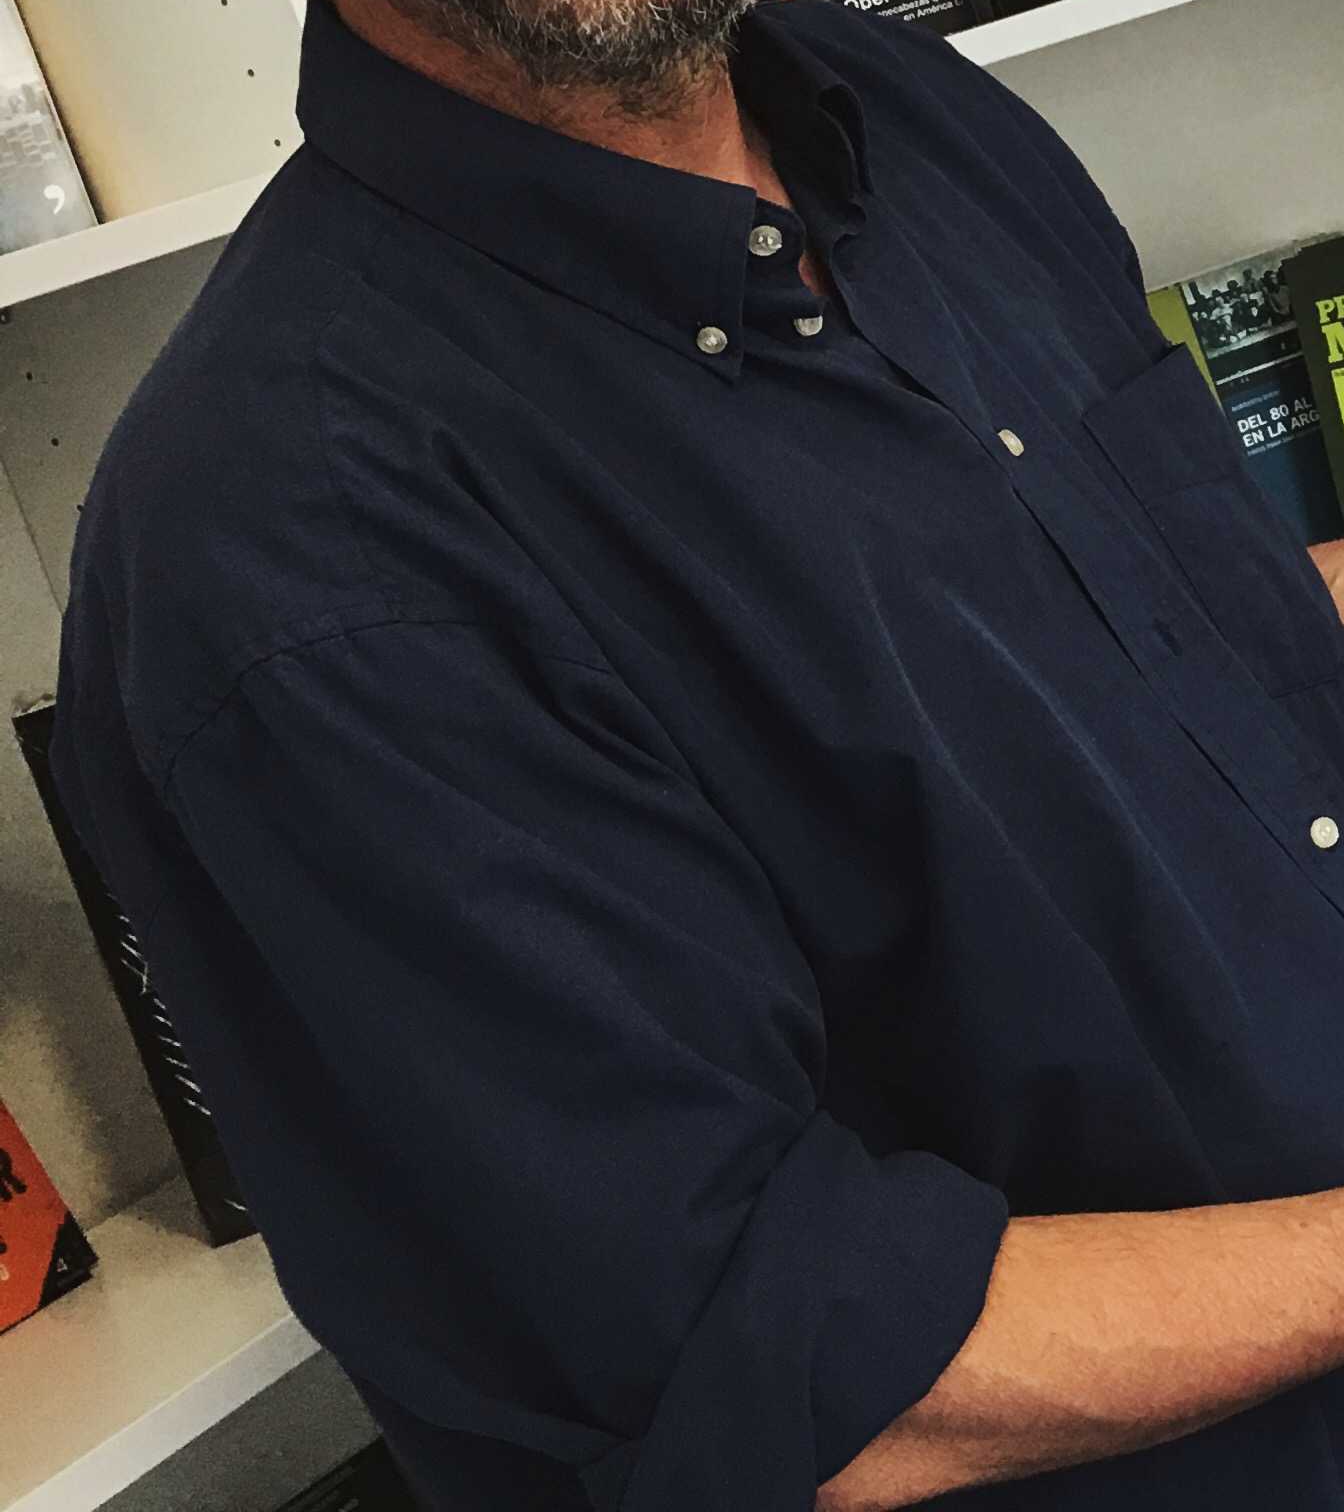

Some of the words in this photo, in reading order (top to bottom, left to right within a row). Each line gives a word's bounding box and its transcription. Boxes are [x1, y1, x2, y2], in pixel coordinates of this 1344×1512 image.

[1237, 411, 1268, 433] DEL
[1270, 405, 1289, 422] 80
[1242, 429, 1264, 448] EN
[1267, 422, 1287, 440] LA
